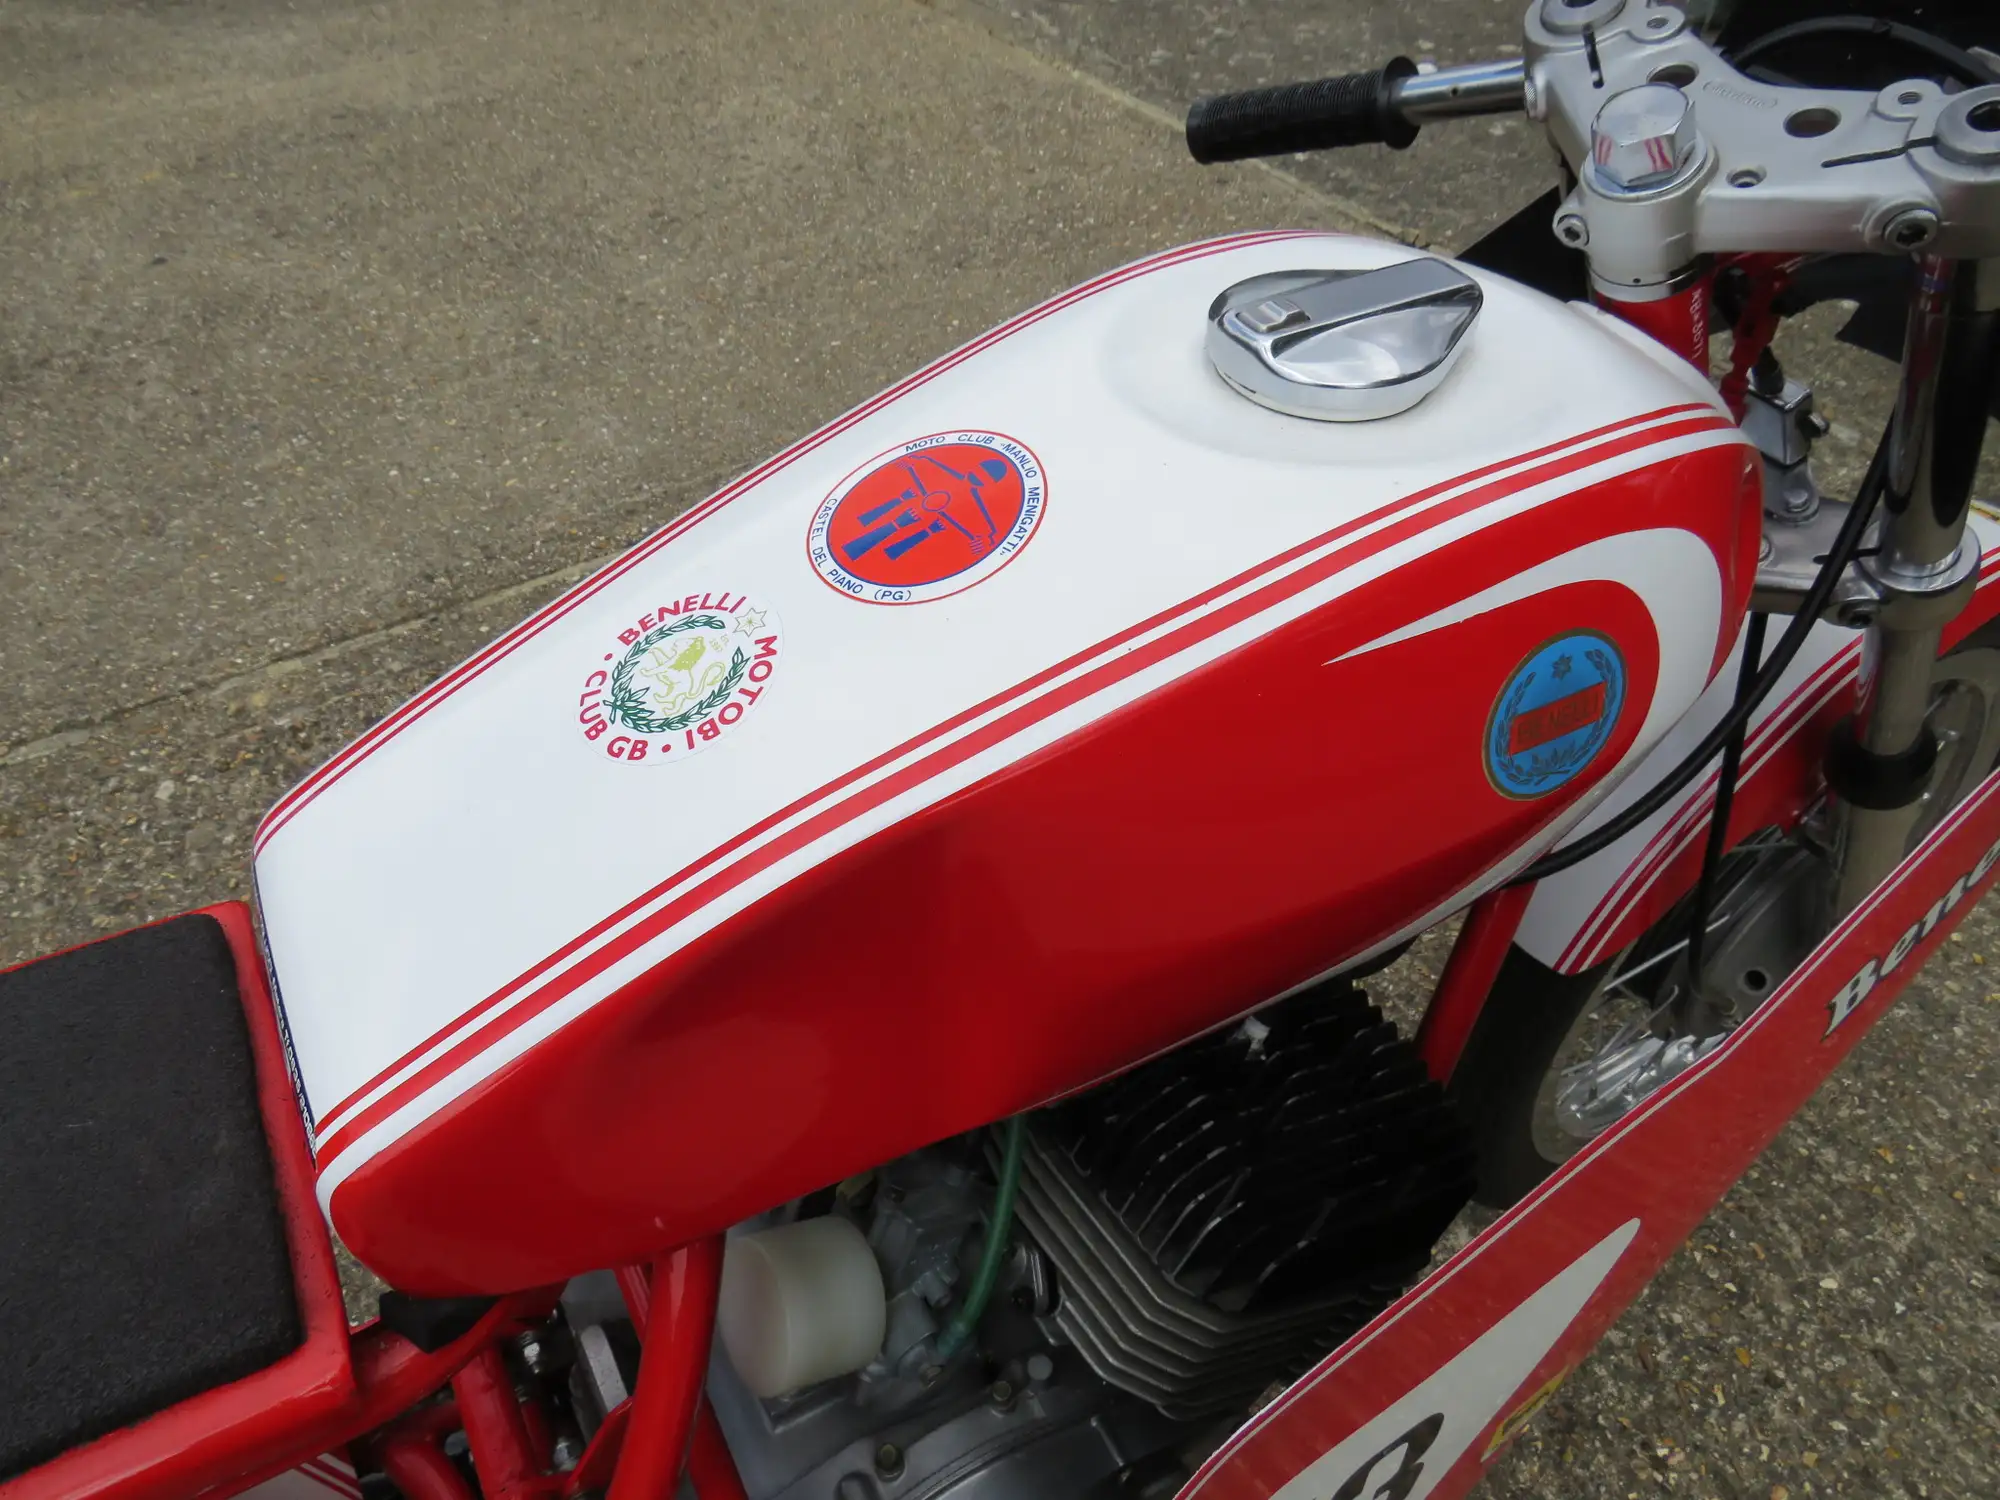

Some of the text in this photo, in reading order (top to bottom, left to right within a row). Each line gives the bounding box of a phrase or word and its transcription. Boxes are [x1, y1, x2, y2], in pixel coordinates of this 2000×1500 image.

[905, 436, 945, 452] MOTO
[958, 434, 995, 444] CLUB
[811, 498, 912, 601] CASTEL DEL PIANO (PG)
[579, 592, 778, 760] BENELLI MOTOBI CLUB GB
